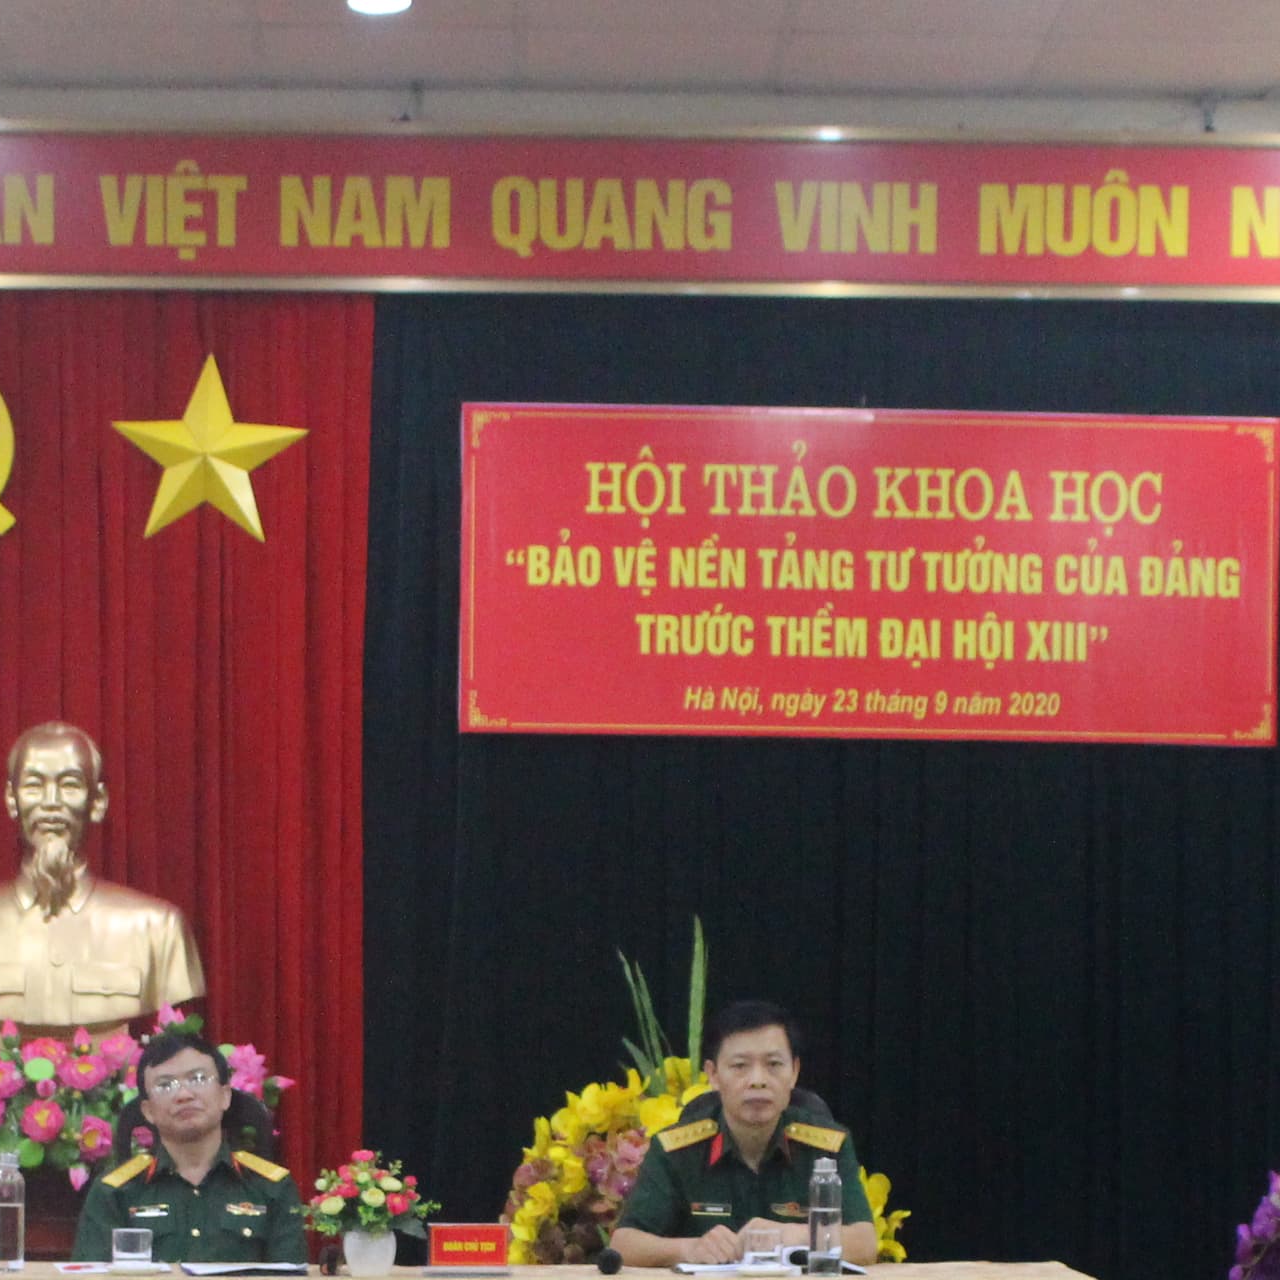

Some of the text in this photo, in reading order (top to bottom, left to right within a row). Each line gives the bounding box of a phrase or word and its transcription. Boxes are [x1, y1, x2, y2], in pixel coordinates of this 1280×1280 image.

[97, 159, 248, 261] VIỆT
[279, 172, 451, 249] NAM
[490, 176, 732, 257] QUANG
[775, 178, 937, 254] VINH
[978, 169, 1189, 259] MUÔN
[586, 442, 1164, 534] HỘI THẢO KHOA HỌC
[613, 545, 656, 597] VỆ
[670, 534, 746, 590] NỀN
[759, 533, 853, 592] TẢNG
[867, 548, 916, 592] TƯ
[922, 538, 1043, 595] TƯỞNG
[1056, 539, 1125, 596] CỦA
[1140, 539, 1241, 600] ĐẢNG
[635, 605, 754, 657] TRƯỚC
[767, 604, 868, 660] THỀM
[880, 616, 941, 667] ĐẠI
[954, 613, 1015, 669] HỘI
[683, 686, 1062, 719] Hà Nội, ngày 23 tháng 9 năm 2020
